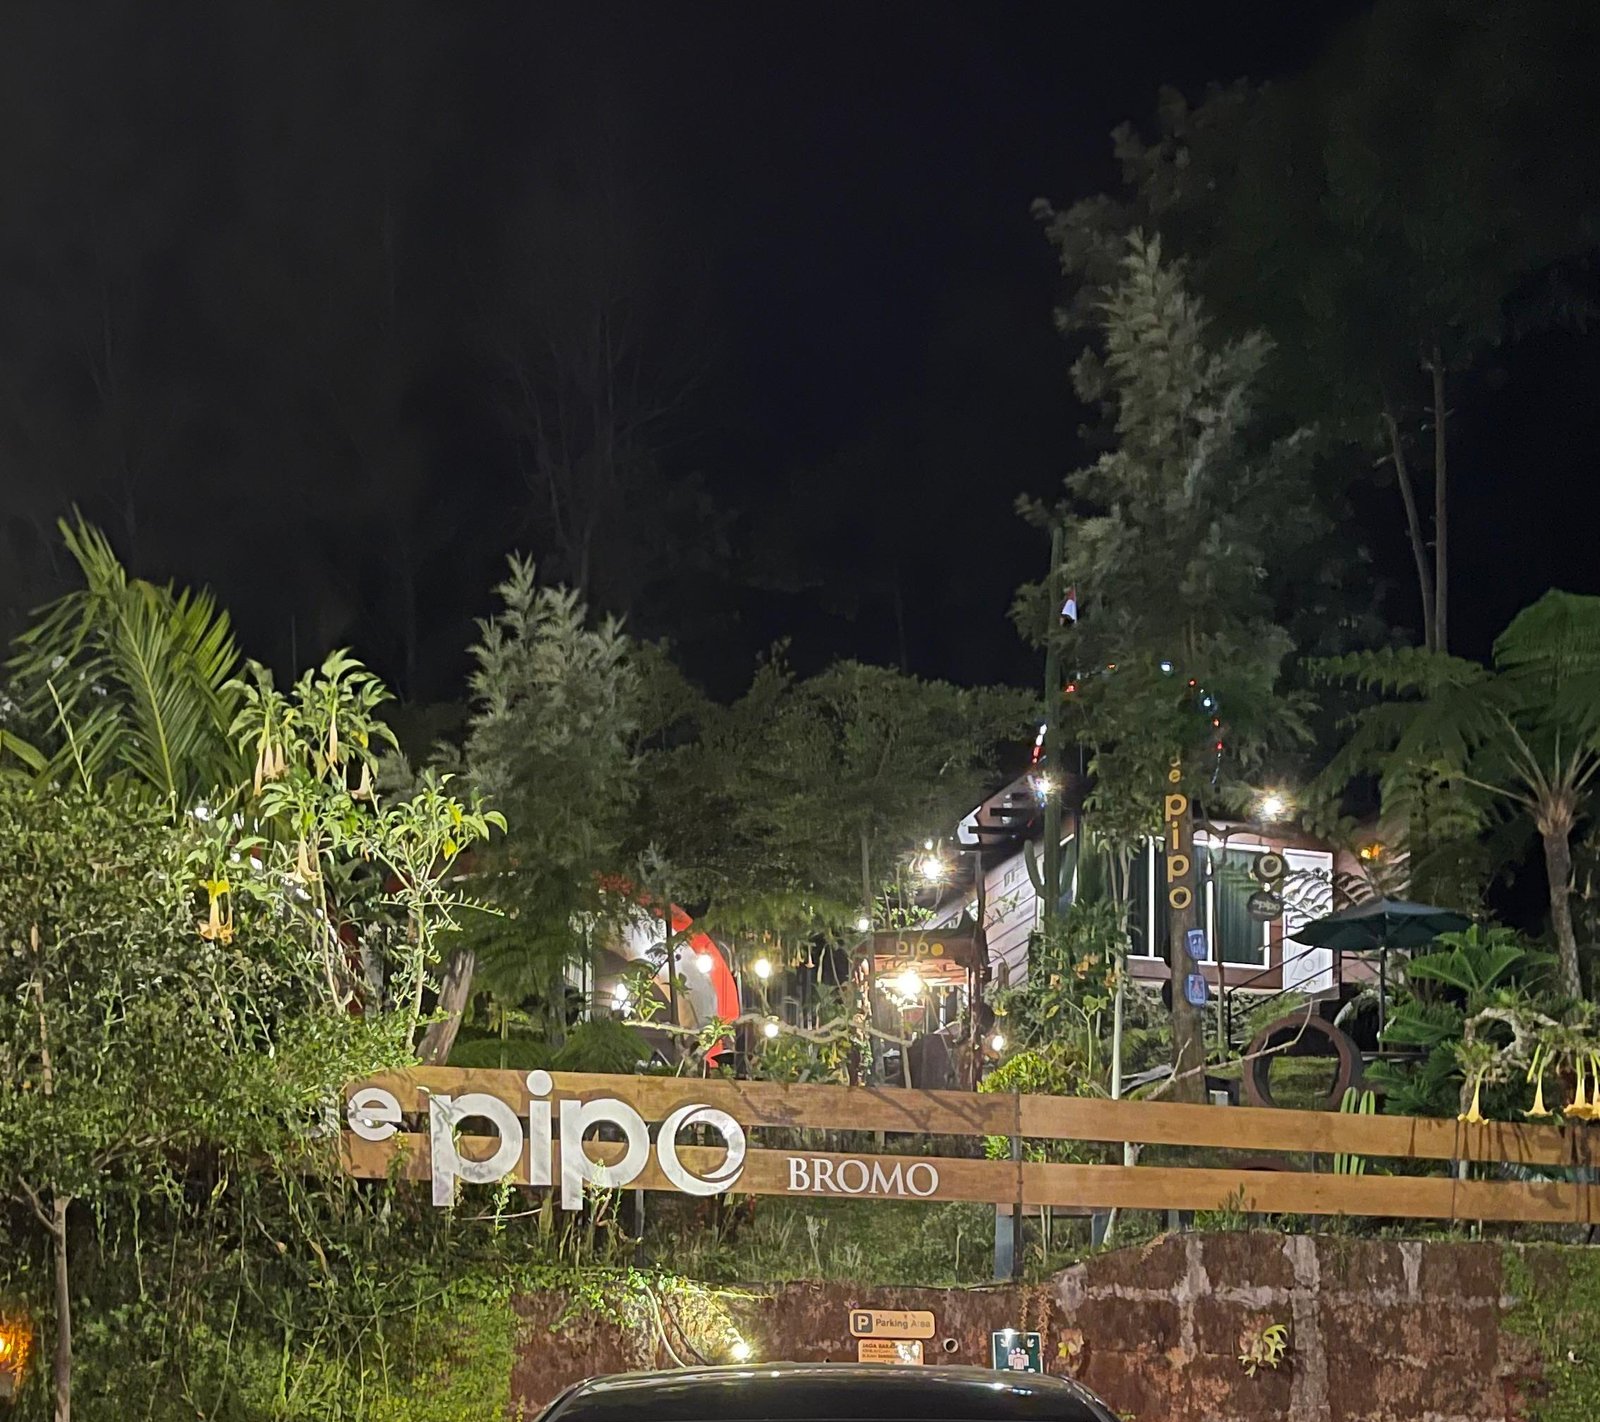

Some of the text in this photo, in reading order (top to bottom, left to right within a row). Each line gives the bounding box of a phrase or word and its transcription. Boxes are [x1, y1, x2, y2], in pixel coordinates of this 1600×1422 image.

[1165, 793, 1192, 909] pipo
[326, 1069, 939, 1210] e pipo BROMO
[875, 1318, 908, 1330] Parking
[911, 1319, 931, 1328] Area
